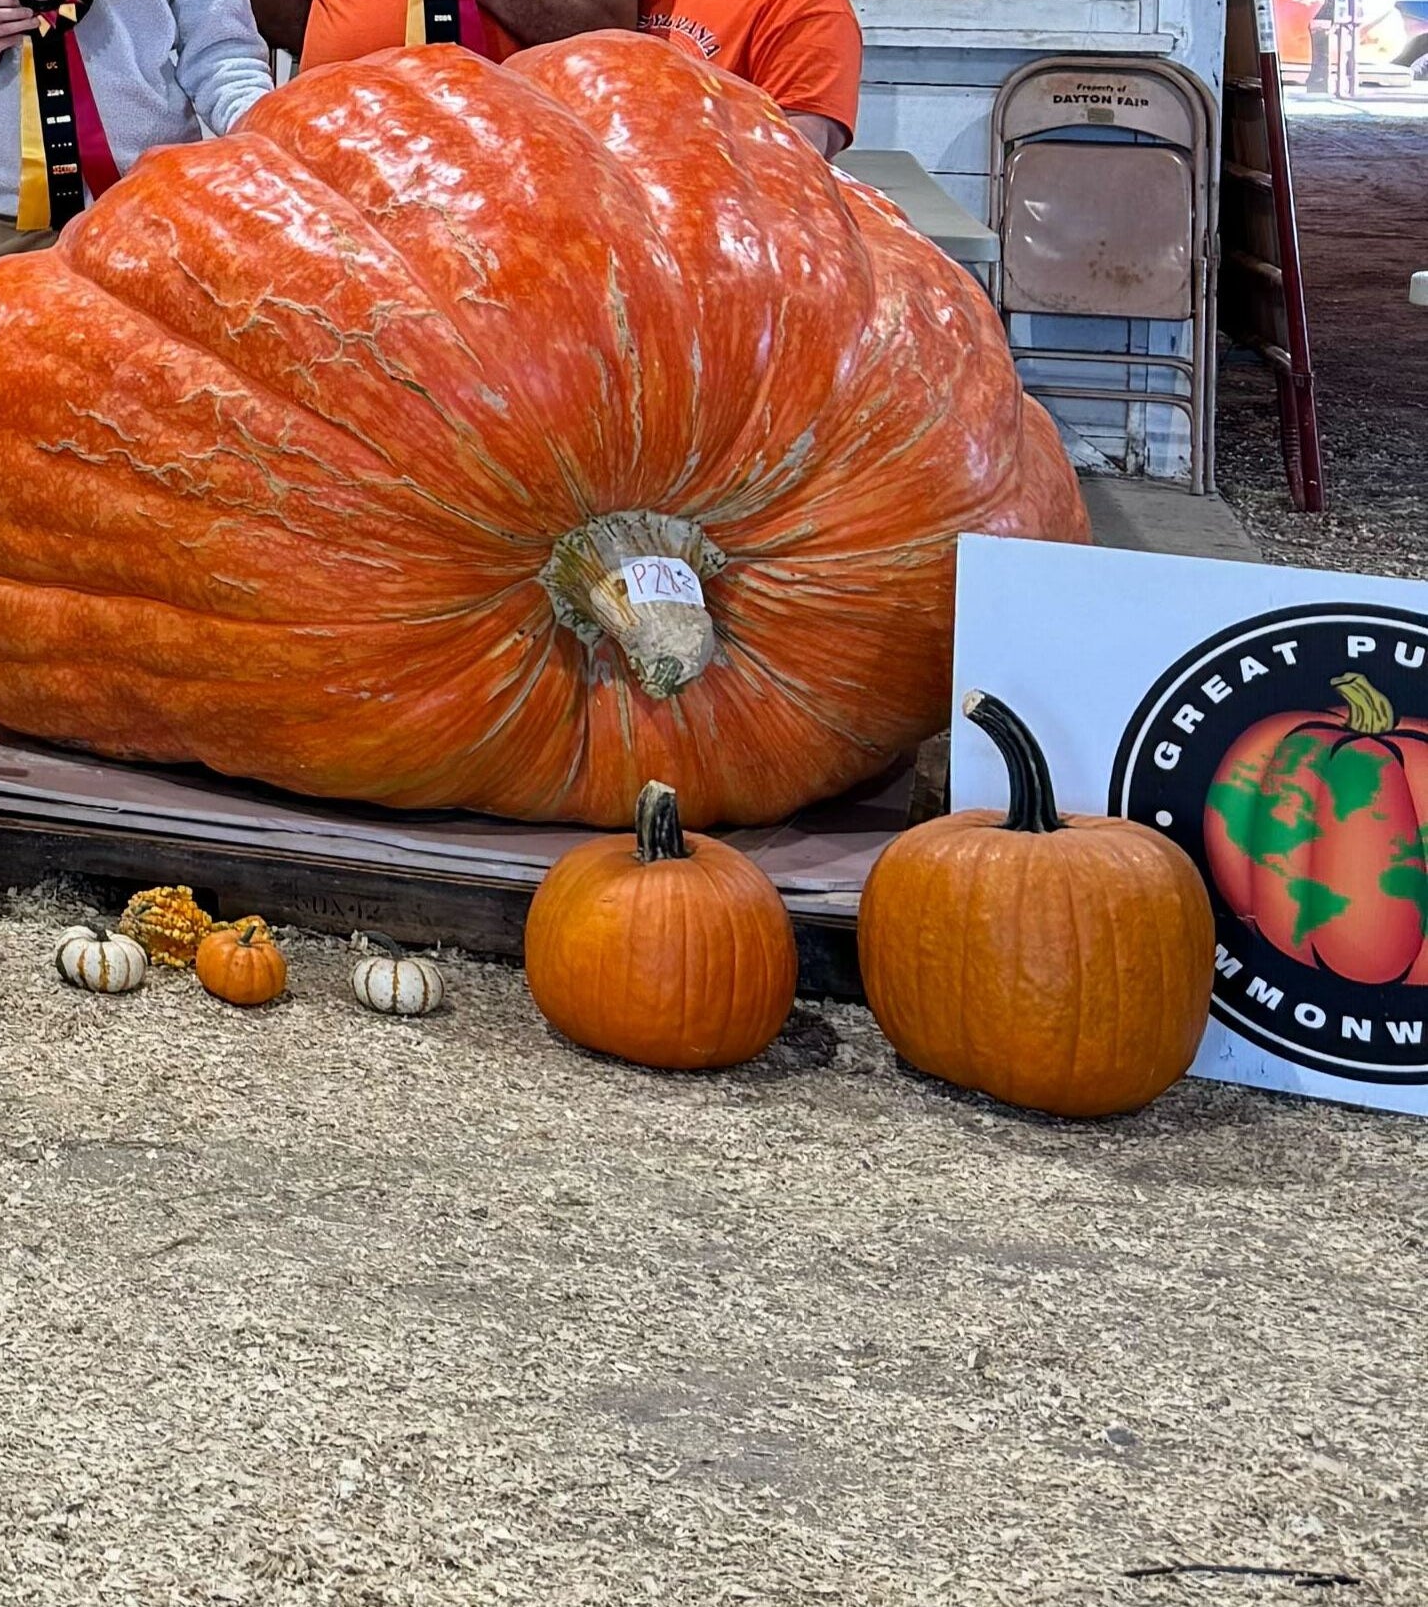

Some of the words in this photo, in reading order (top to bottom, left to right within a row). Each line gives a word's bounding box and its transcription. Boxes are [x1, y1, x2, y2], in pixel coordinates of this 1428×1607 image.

[637, 13, 721, 61] SYLVANIA
[1053, 94, 1112, 105] DAYTON
[1117, 96, 1149, 107] FAIR
[1076, 83, 1114, 92] Property
[1153, 639, 1299, 771] GREAT
[1346, 634, 1428, 670] PU
